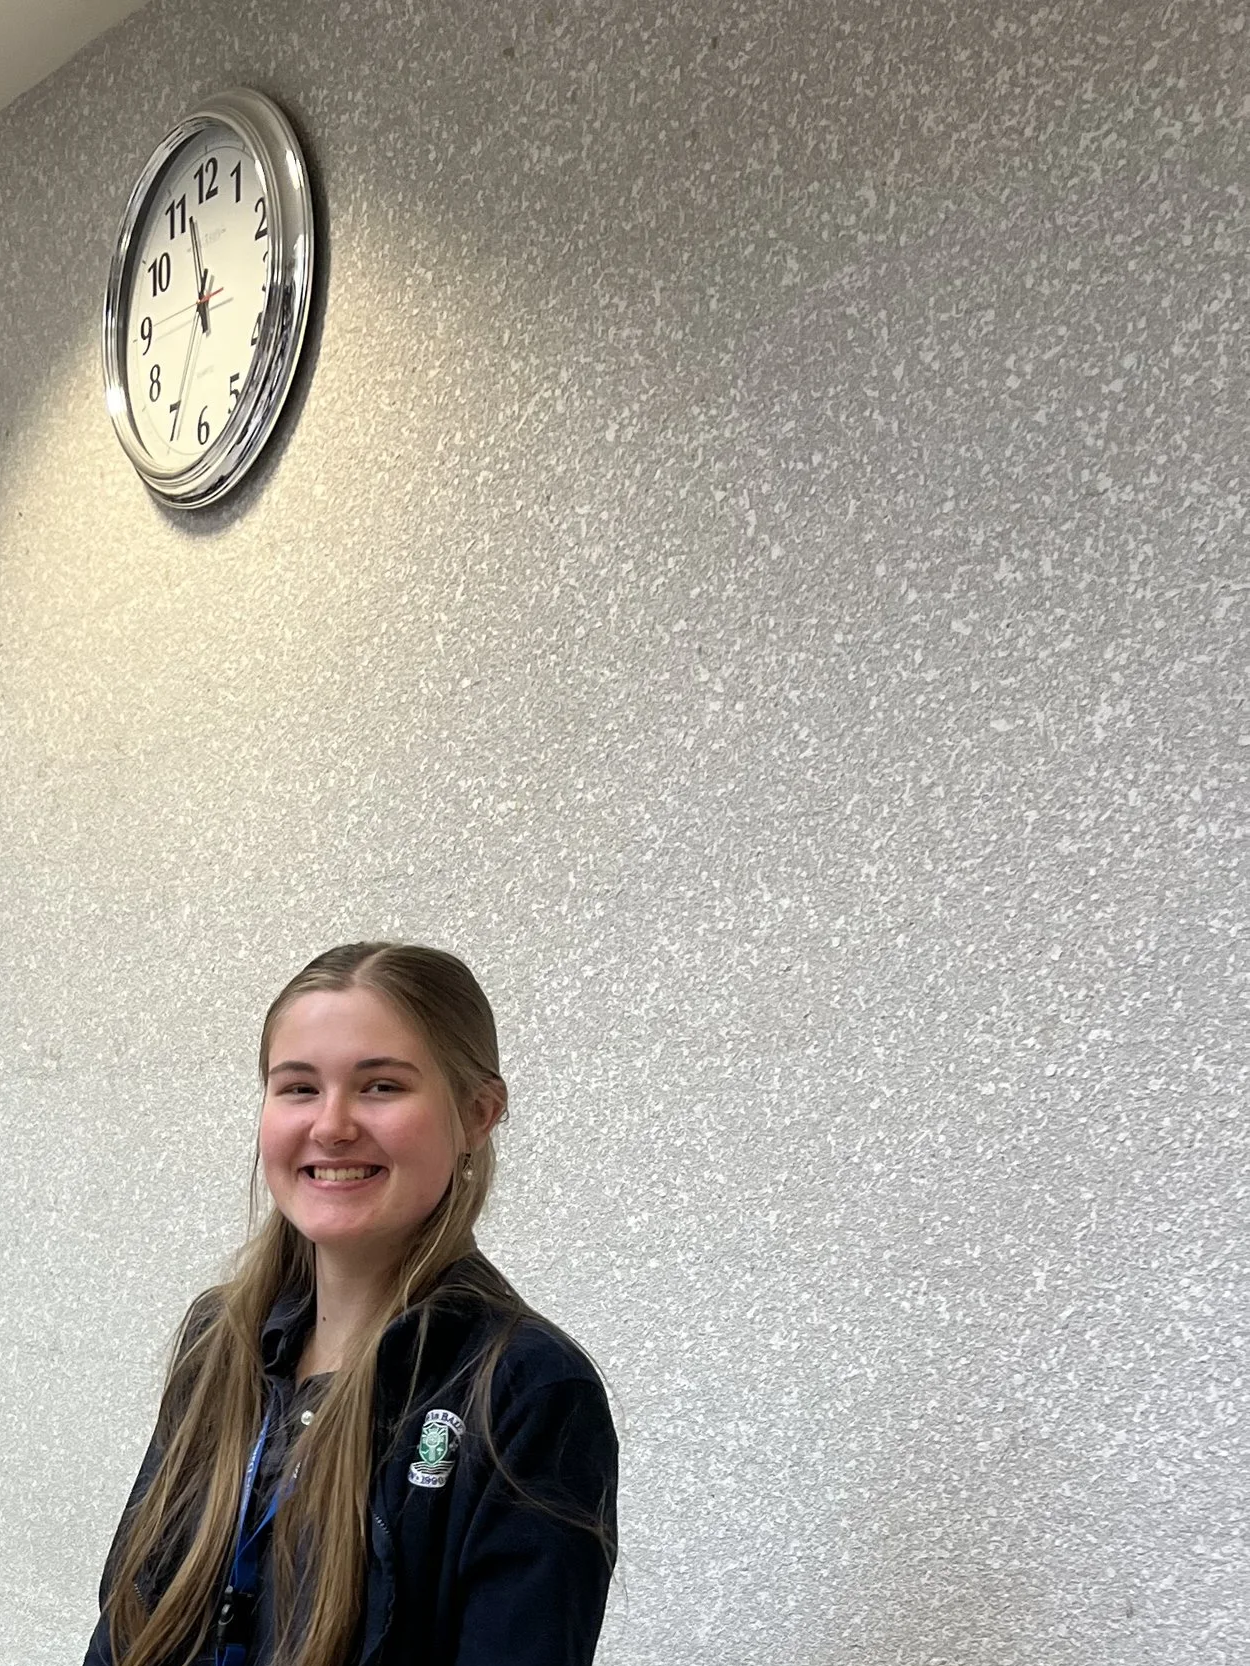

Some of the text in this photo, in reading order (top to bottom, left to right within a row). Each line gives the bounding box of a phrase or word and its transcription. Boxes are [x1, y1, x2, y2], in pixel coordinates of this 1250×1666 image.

[193, 157, 218, 205] 12
[230, 160, 243, 203] 1
[164, 193, 188, 240] 11
[254, 196, 268, 241] 2
[147, 251, 171, 297] 10
[140, 316, 152, 356] 9
[148, 364, 161, 403] 8
[169, 400, 181, 443] 7
[196, 405, 210, 446] 6
